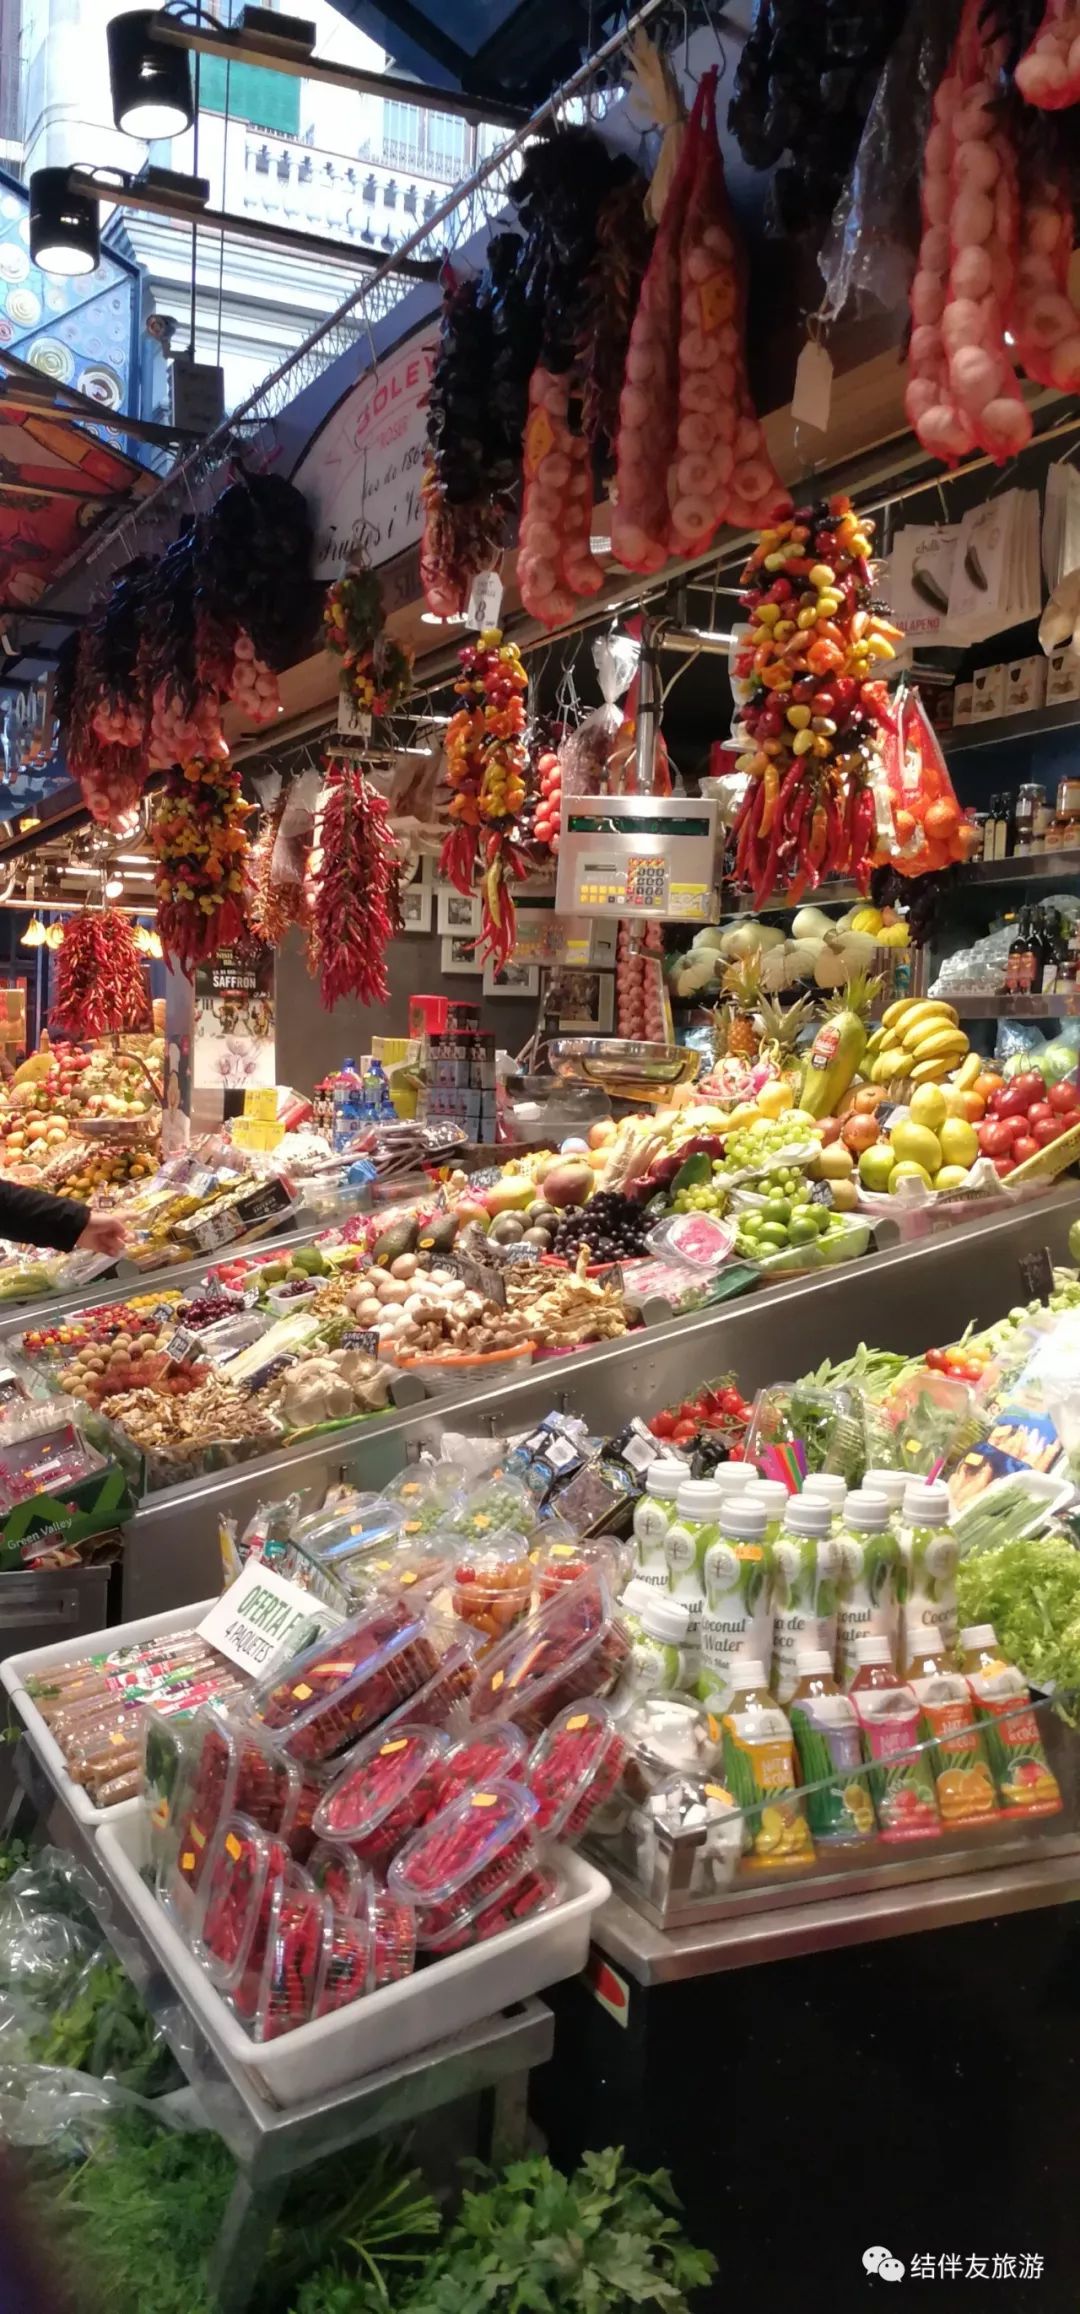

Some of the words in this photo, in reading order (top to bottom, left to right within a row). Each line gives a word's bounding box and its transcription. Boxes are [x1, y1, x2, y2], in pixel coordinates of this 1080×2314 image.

[212, 975, 257, 989] SAFFRON
[7, 1533, 39, 1550] Green
[40, 1518, 72, 1536] Valley
[237, 1584, 293, 1638] OFERTA
[230, 1623, 274, 1664] PAQUETES
